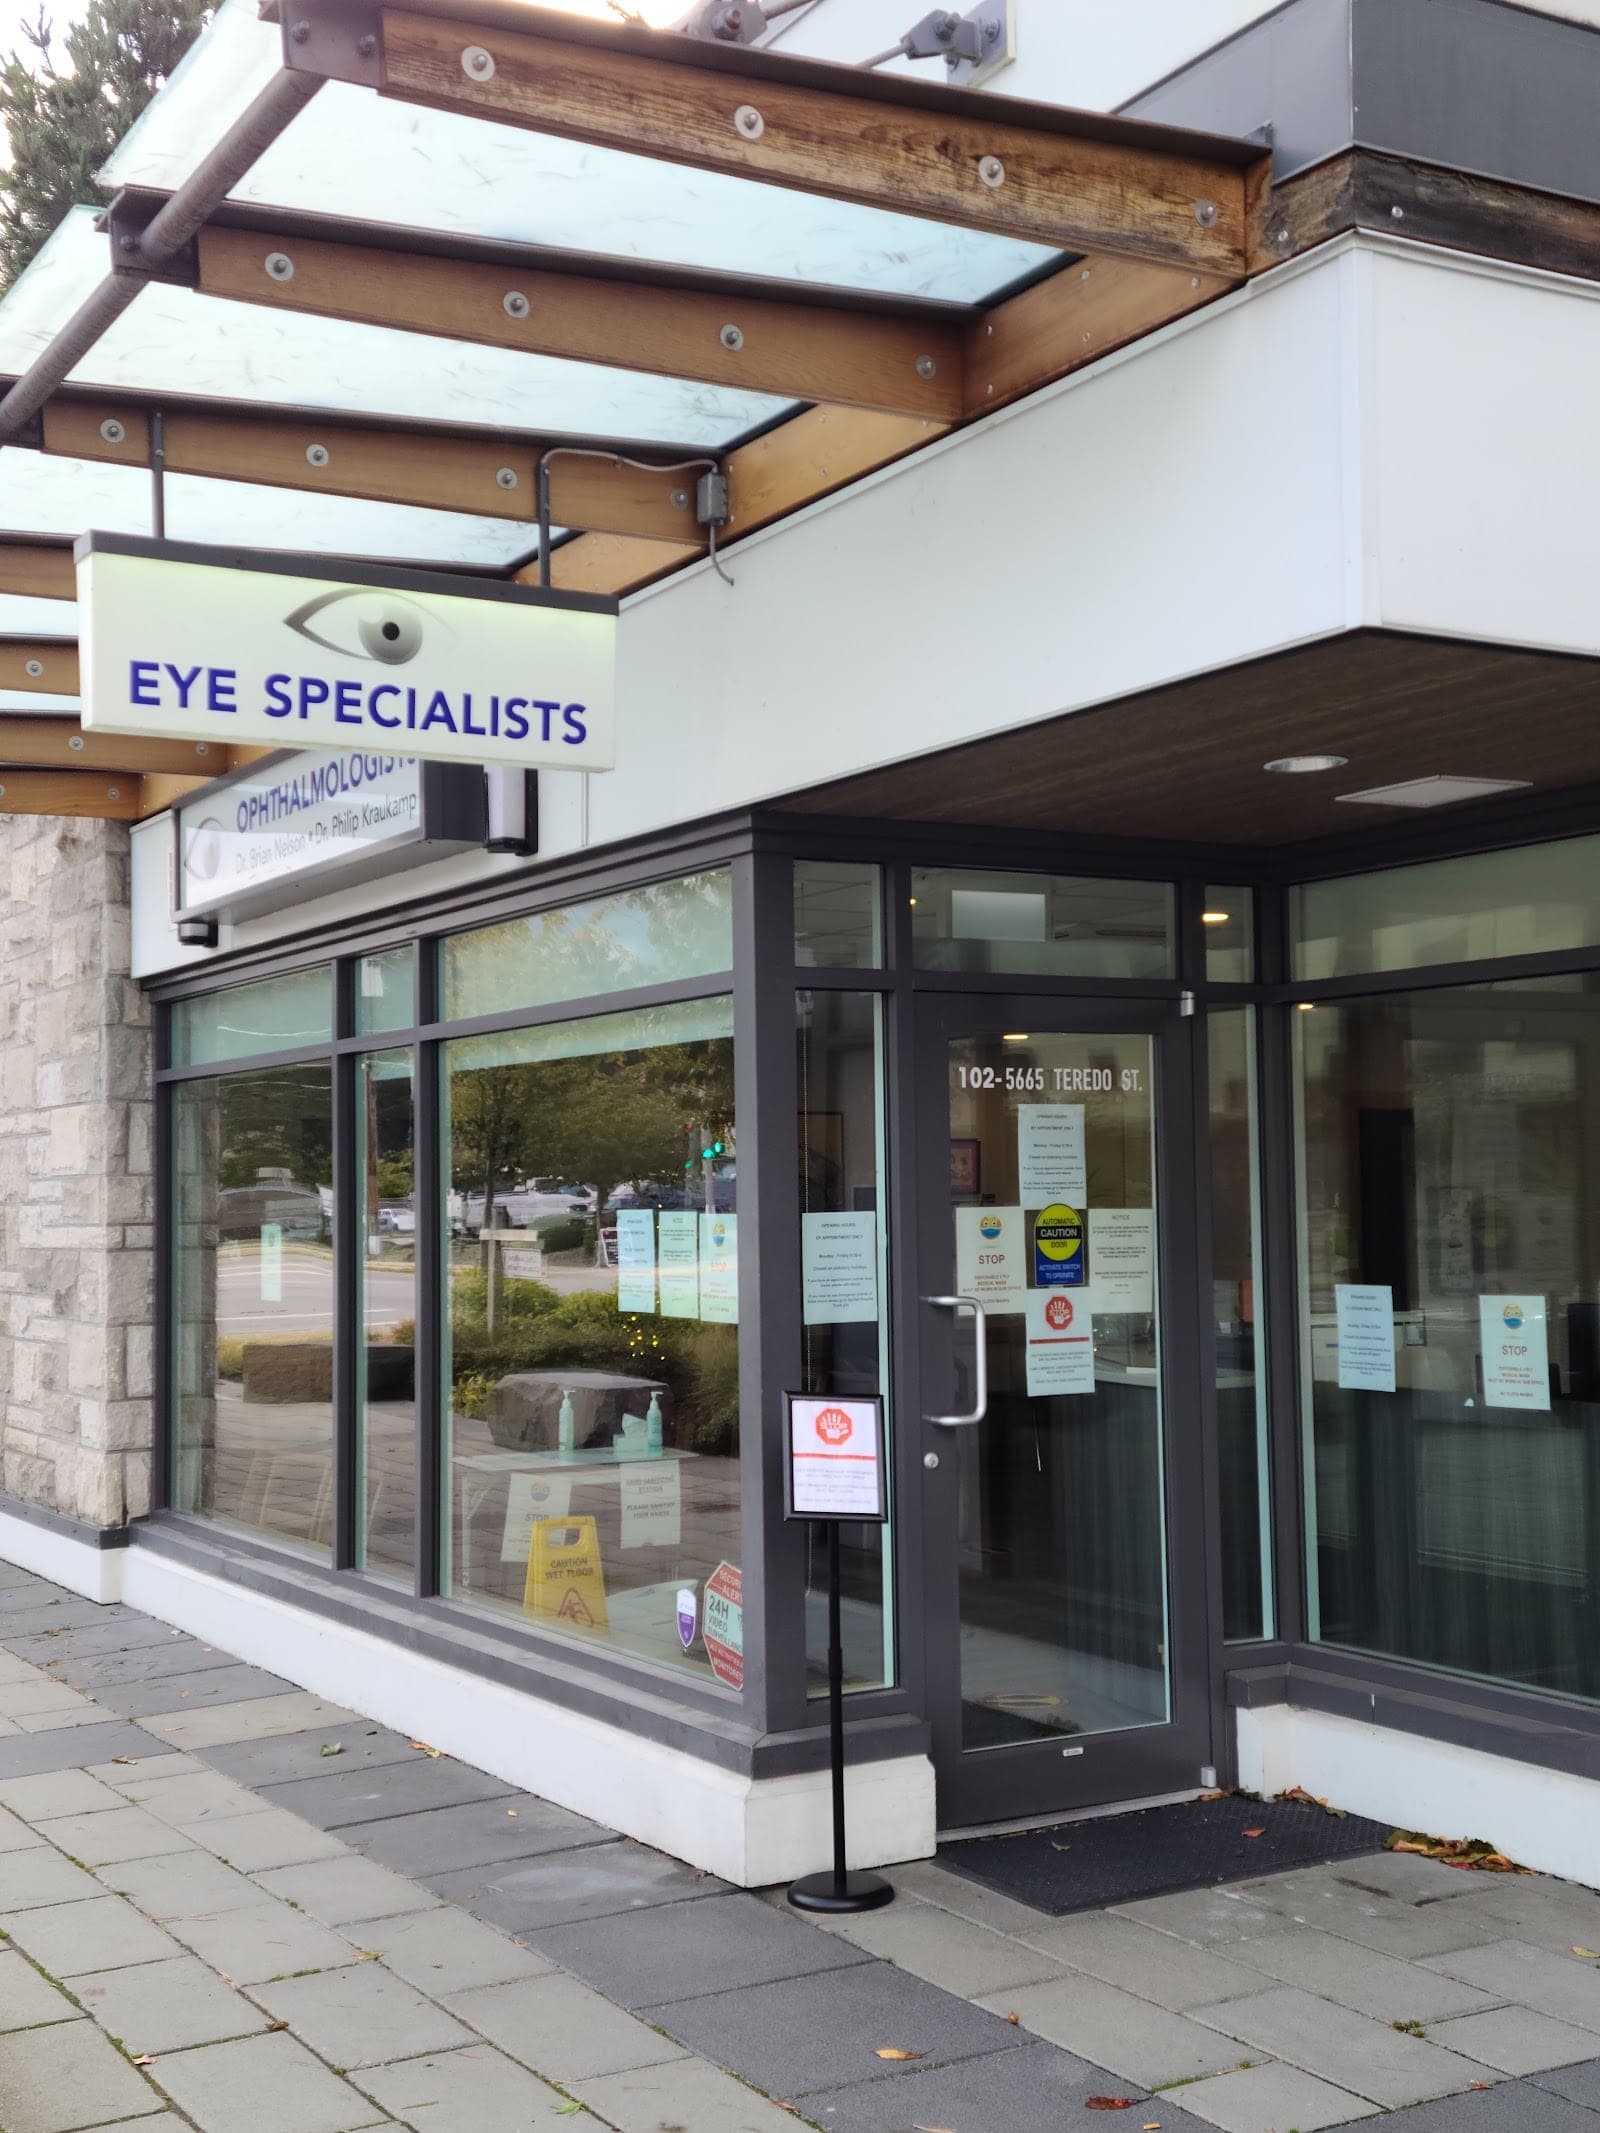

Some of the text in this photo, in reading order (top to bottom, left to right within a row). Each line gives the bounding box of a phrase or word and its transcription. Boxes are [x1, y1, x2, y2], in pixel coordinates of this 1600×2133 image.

[129, 660, 587, 745] EYE SPECIALISTS
[250, 844, 272, 870] Brian
[274, 833, 306, 861] Nelson
[315, 821, 328, 845] Dr.
[332, 809, 358, 839] Philip
[362, 793, 416, 828] Kraukamp
[1054, 1068, 1112, 1091] TEREDO
[1121, 1069, 1143, 1092] ST.
[1040, 1228, 1078, 1238] CAUTION
[1050, 1241, 1068, 1249] DOOR
[978, 1254, 1005, 1264] STOP
[1502, 1345, 1528, 1356] STOP
[550, 1557, 588, 1569] CAUTION
[545, 1568, 593, 1580] WET FLOOR
[708, 1594, 729, 1622] 24H
[708, 1612, 728, 1633] VIDEO
